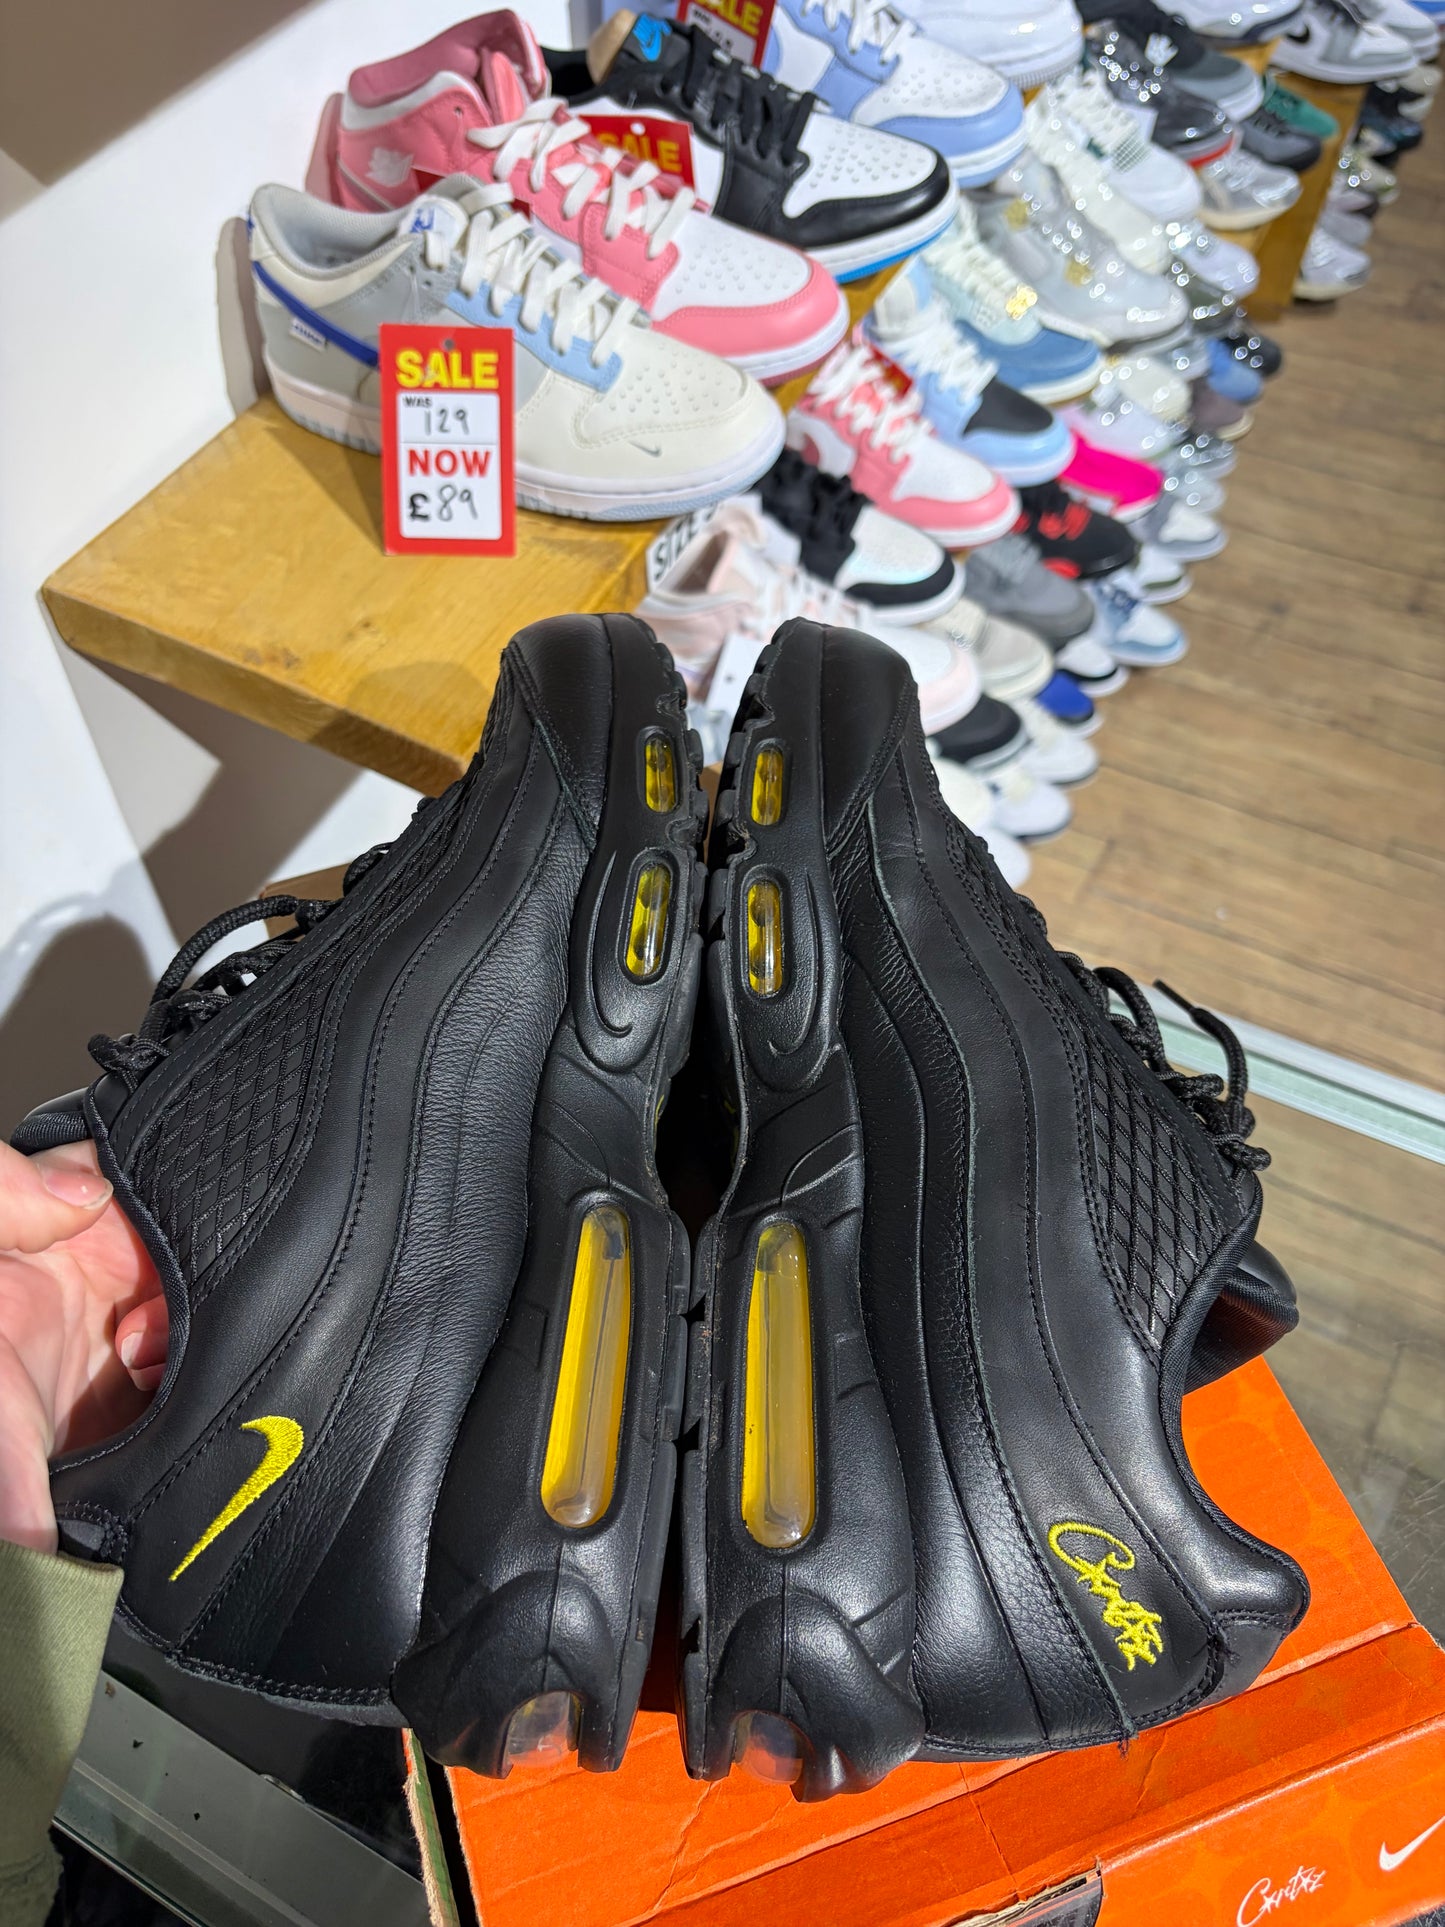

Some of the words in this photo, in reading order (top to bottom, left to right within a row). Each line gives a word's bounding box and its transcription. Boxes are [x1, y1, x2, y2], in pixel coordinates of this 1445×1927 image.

[693, 0, 763, 37] ALE
[396, 350, 498, 389] SALE
[424, 408, 469, 435] 129
[408, 449, 491, 477] NOW
[408, 484, 479, 522] £89
